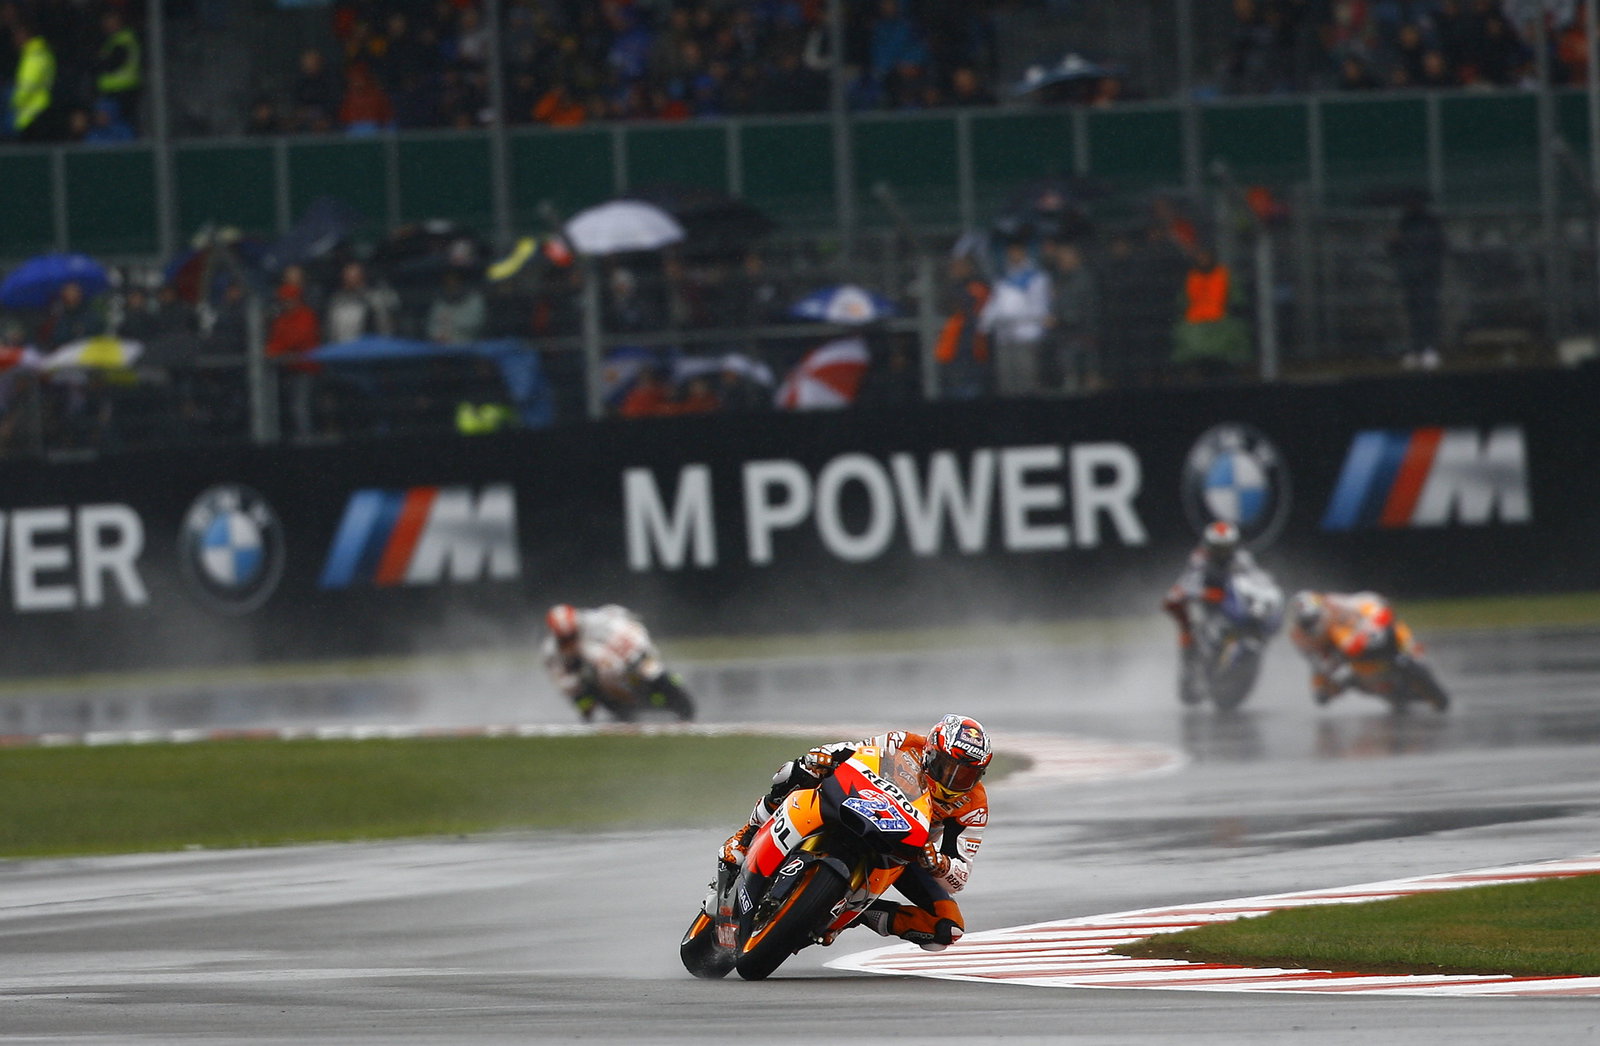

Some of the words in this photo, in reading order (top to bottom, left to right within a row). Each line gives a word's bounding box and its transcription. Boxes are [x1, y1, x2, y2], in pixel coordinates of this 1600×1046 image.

[623, 464, 716, 571] M
[744, 441, 1147, 565] POWER
[0, 503, 149, 611] ER
[953, 740, 986, 756] NOLAN
[841, 789, 912, 832] 27
[862, 769, 920, 820] REPSOL
